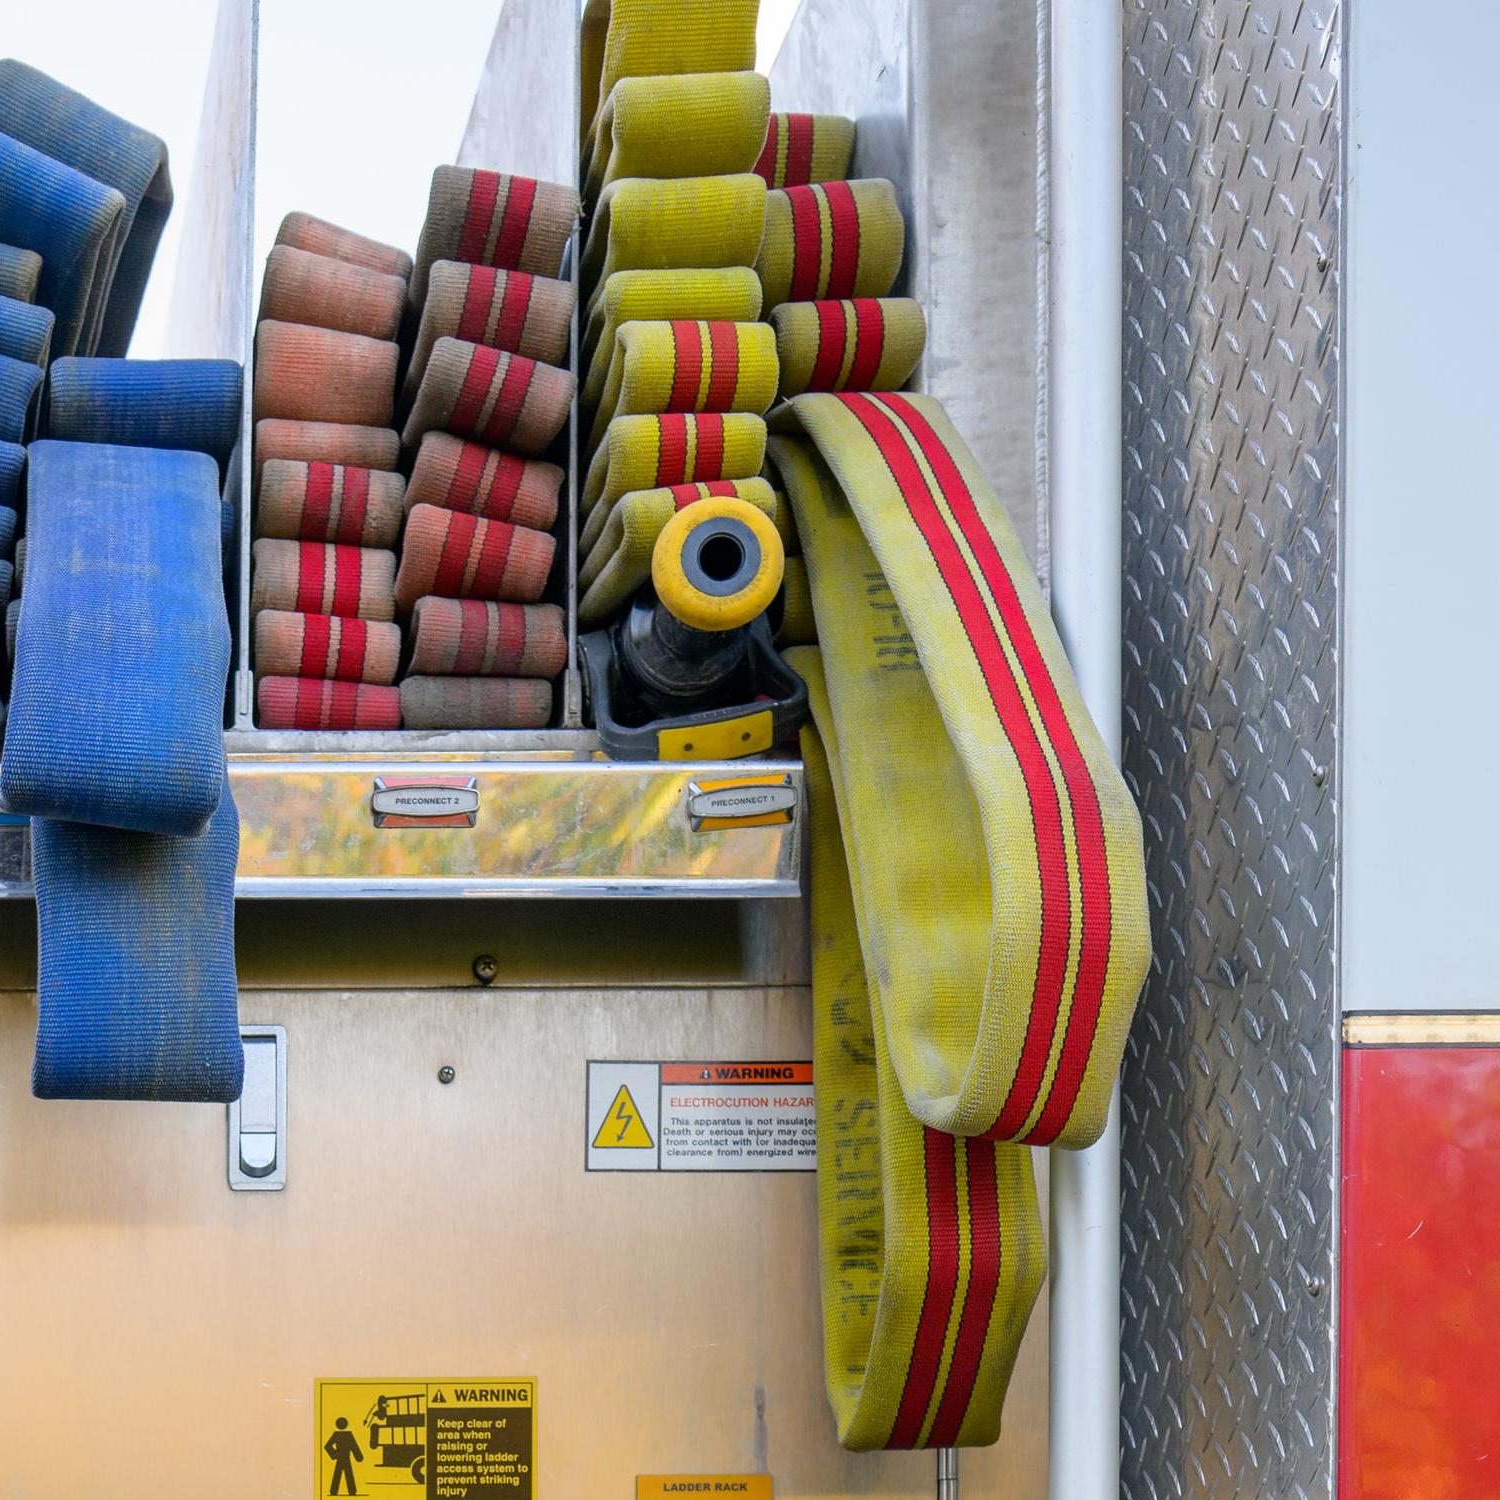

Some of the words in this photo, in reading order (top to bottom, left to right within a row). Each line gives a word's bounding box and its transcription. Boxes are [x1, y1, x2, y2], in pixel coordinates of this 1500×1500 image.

[711, 797, 768, 807] PRECONNECT
[716, 1068, 794, 1079] WARNING
[670, 1098, 768, 1107] ELECTROCUTION
[773, 1098, 814, 1107] HAZAR
[671, 1117, 690, 1125] This
[694, 1118, 741, 1127] apparatus
[745, 1117, 753, 1125] is
[777, 1117, 816, 1126] insulate
[663, 1128, 691, 1136] Death
[748, 1128, 773, 1137] injury
[778, 1129, 797, 1137] may
[666, 1138, 688, 1146] from
[692, 1138, 728, 1146] contact
[732, 1138, 752, 1146] with
[756, 1138, 769, 1147] (or
[773, 1138, 816, 1147] inadequa
[667, 1148, 713, 1156] clearance
[717, 1148, 743, 1157] from)
[747, 1148, 793, 1158] energized
[454, 1389, 528, 1402] WARNING
[437, 1419, 464, 1430] Keep
[467, 1419, 493, 1428] clear
[495, 1418, 507, 1428] of
[437, 1431, 460, 1439] area
[462, 1430, 491, 1439] when
[437, 1441, 473, 1452] raising
[437, 1453, 482, 1463] lowering
[485, 1452, 519, 1461] ladder
[437, 1465, 474, 1473] access
[476, 1464, 514, 1474] system
[517, 1464, 528, 1472] to
[437, 1475, 477, 1486] prevent
[480, 1475, 520, 1486] striking
[437, 1486, 467, 1497] injury
[663, 1483, 711, 1491] LADDER
[715, 1483, 748, 1491] RACK
